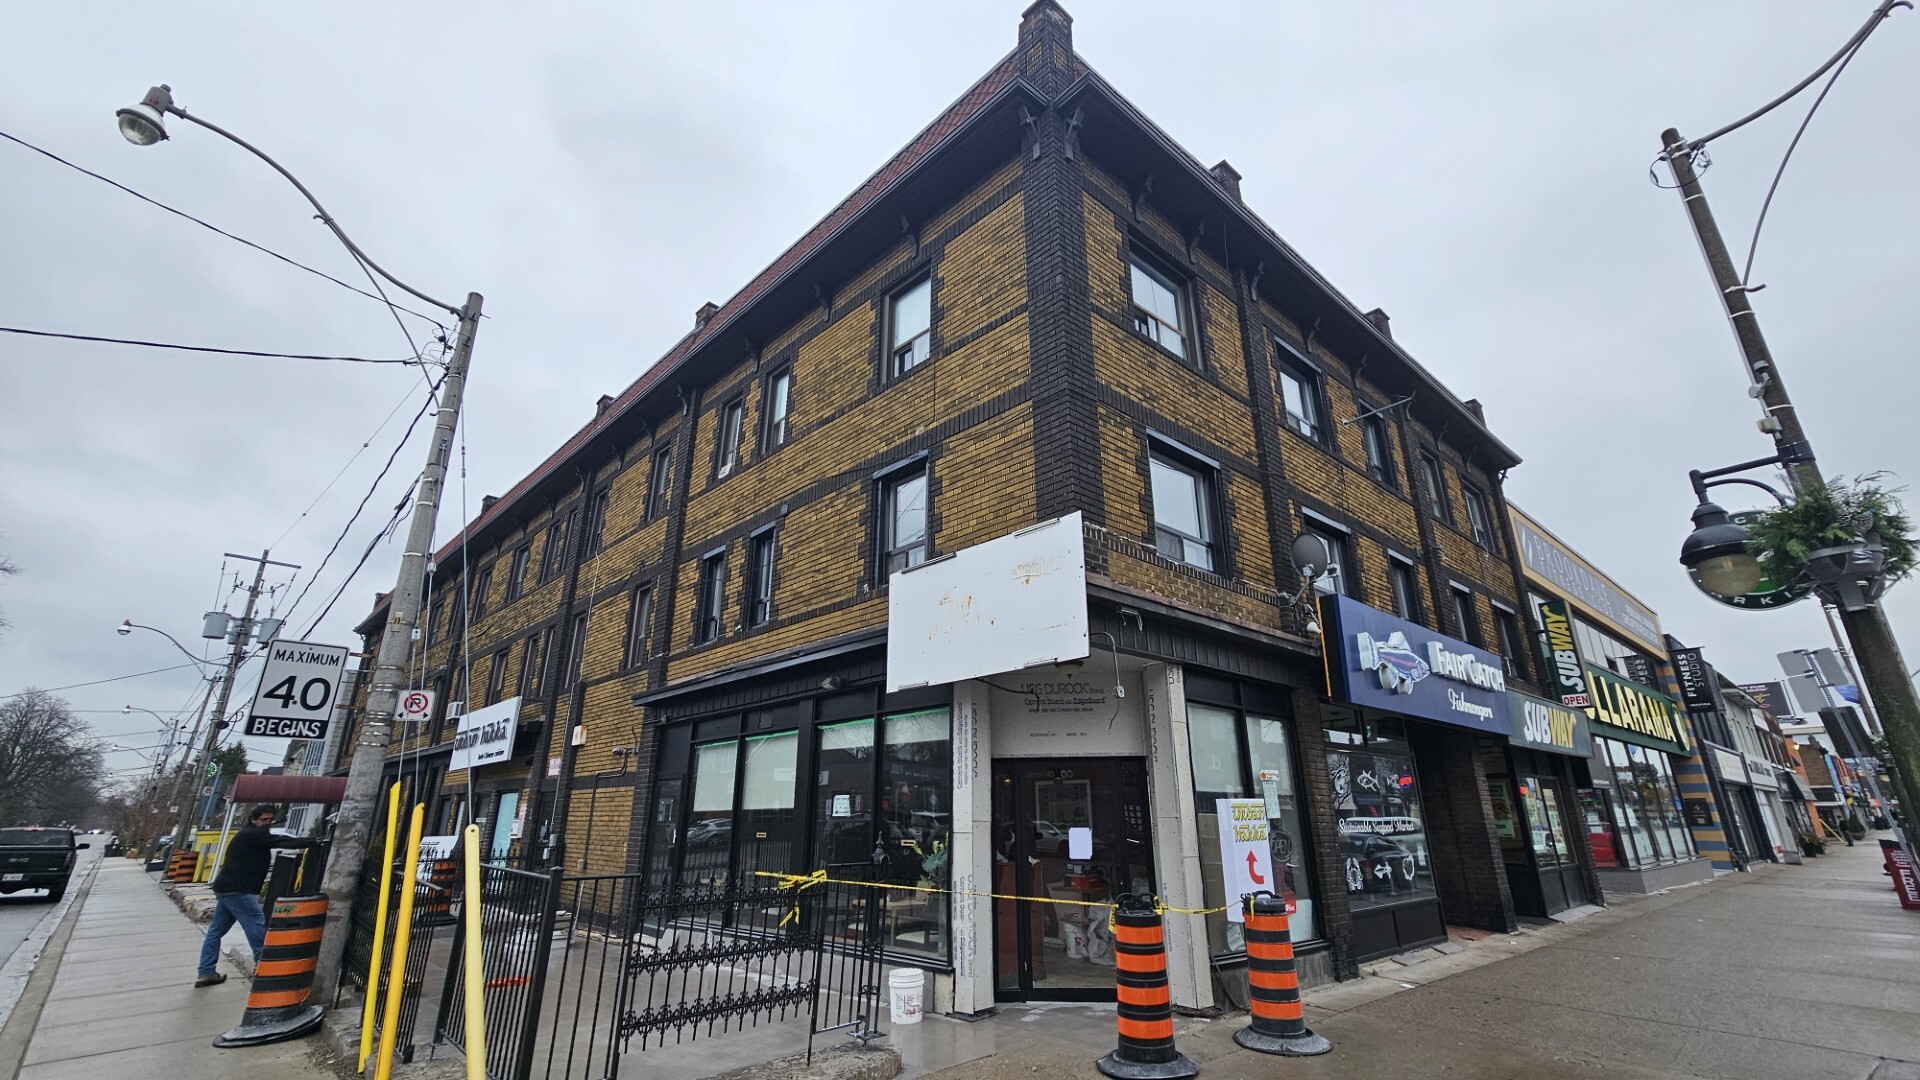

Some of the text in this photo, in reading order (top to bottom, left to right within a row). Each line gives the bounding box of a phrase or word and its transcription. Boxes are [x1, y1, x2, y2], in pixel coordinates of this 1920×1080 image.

[1533, 535, 1611, 606] BROOKDALE
[274, 649, 340, 667] MAXIMUM
[1427, 641, 1505, 693] FAIR CATCH
[1541, 605, 1585, 693] SUBWAY
[1677, 653, 1698, 697] FITNESS
[1687, 652, 1705, 688] STUDIO
[263, 675, 331, 711] 40
[1448, 688, 1493, 721] Fishmongers
[1563, 695, 1589, 705] OPEN
[1584, 671, 1677, 743] LLARAMA
[252, 718, 321, 737] BEGINS
[1524, 701, 1576, 748] SUBWAY
[1338, 818, 1414, 835] Sustainable Seafood Market
